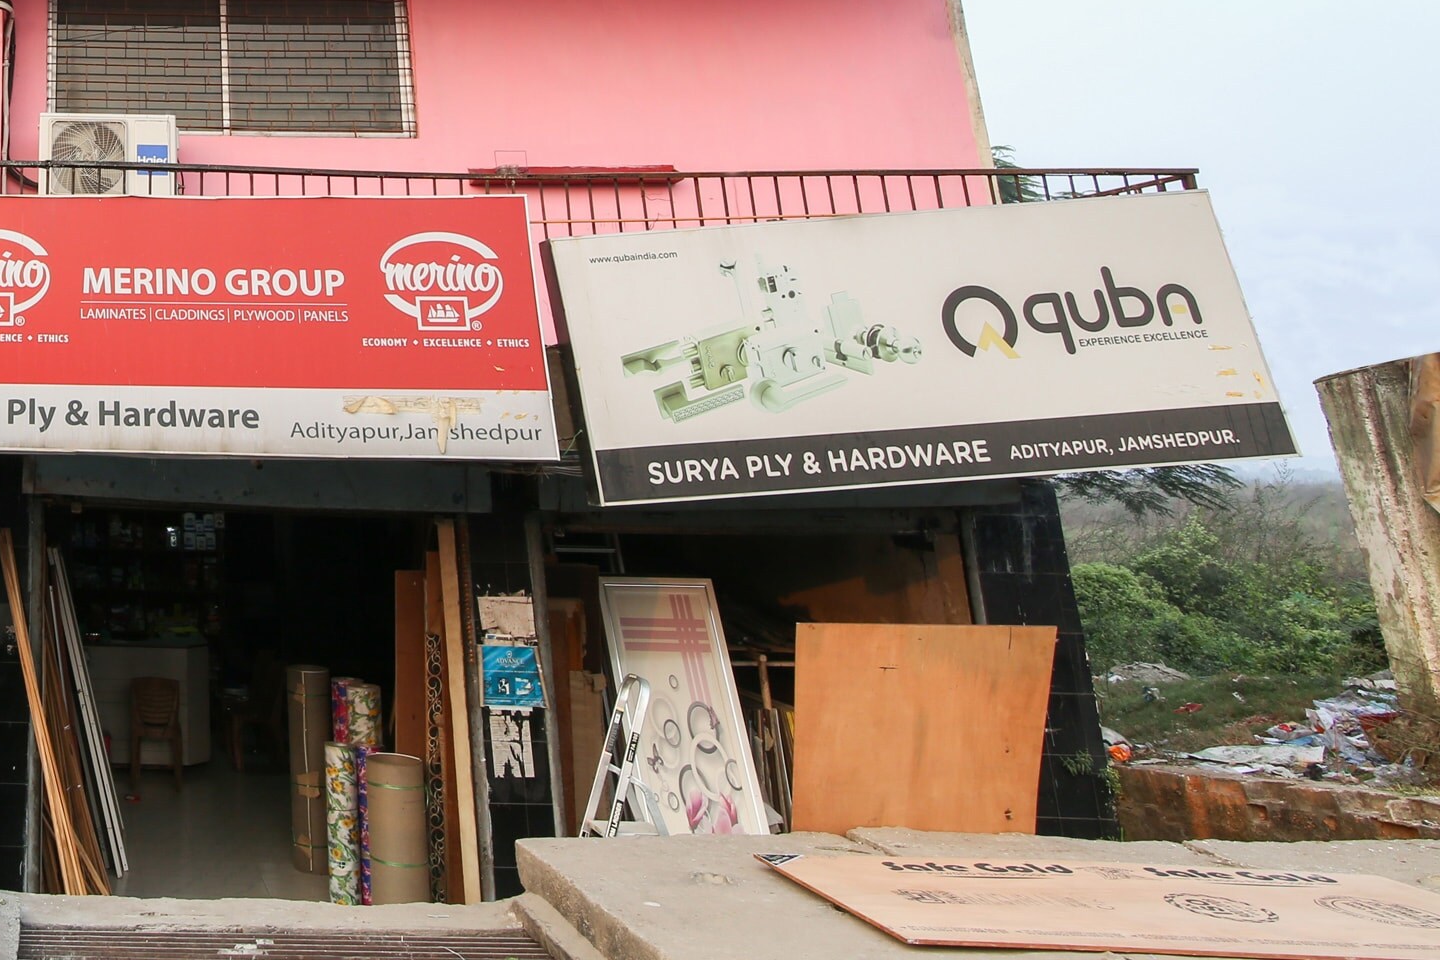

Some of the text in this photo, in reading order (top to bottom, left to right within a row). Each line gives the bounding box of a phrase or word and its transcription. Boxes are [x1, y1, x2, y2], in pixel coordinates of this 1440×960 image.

[589, 250, 678, 264] www.qubaindia.com
[384, 255, 495, 291] merino
[83, 268, 345, 297] MERINO GROUP
[80, 308, 349, 322] LAMINATES CLADDINGS PLYWOOD PANELS
[37, 333, 69, 343] ETHICS
[362, 338, 530, 348] ECONOMY EXCELLENCE ETHICS
[1078, 330, 1209, 347] EXPERIENCE EXCELLENCE
[7, 398, 56, 432] Ply
[65, 400, 89, 426] &
[99, 401, 260, 428] Hardware
[648, 428, 1240, 485] SURYA PLY & HARDWARE ADITYAPUR, JAMSHEDPUR.
